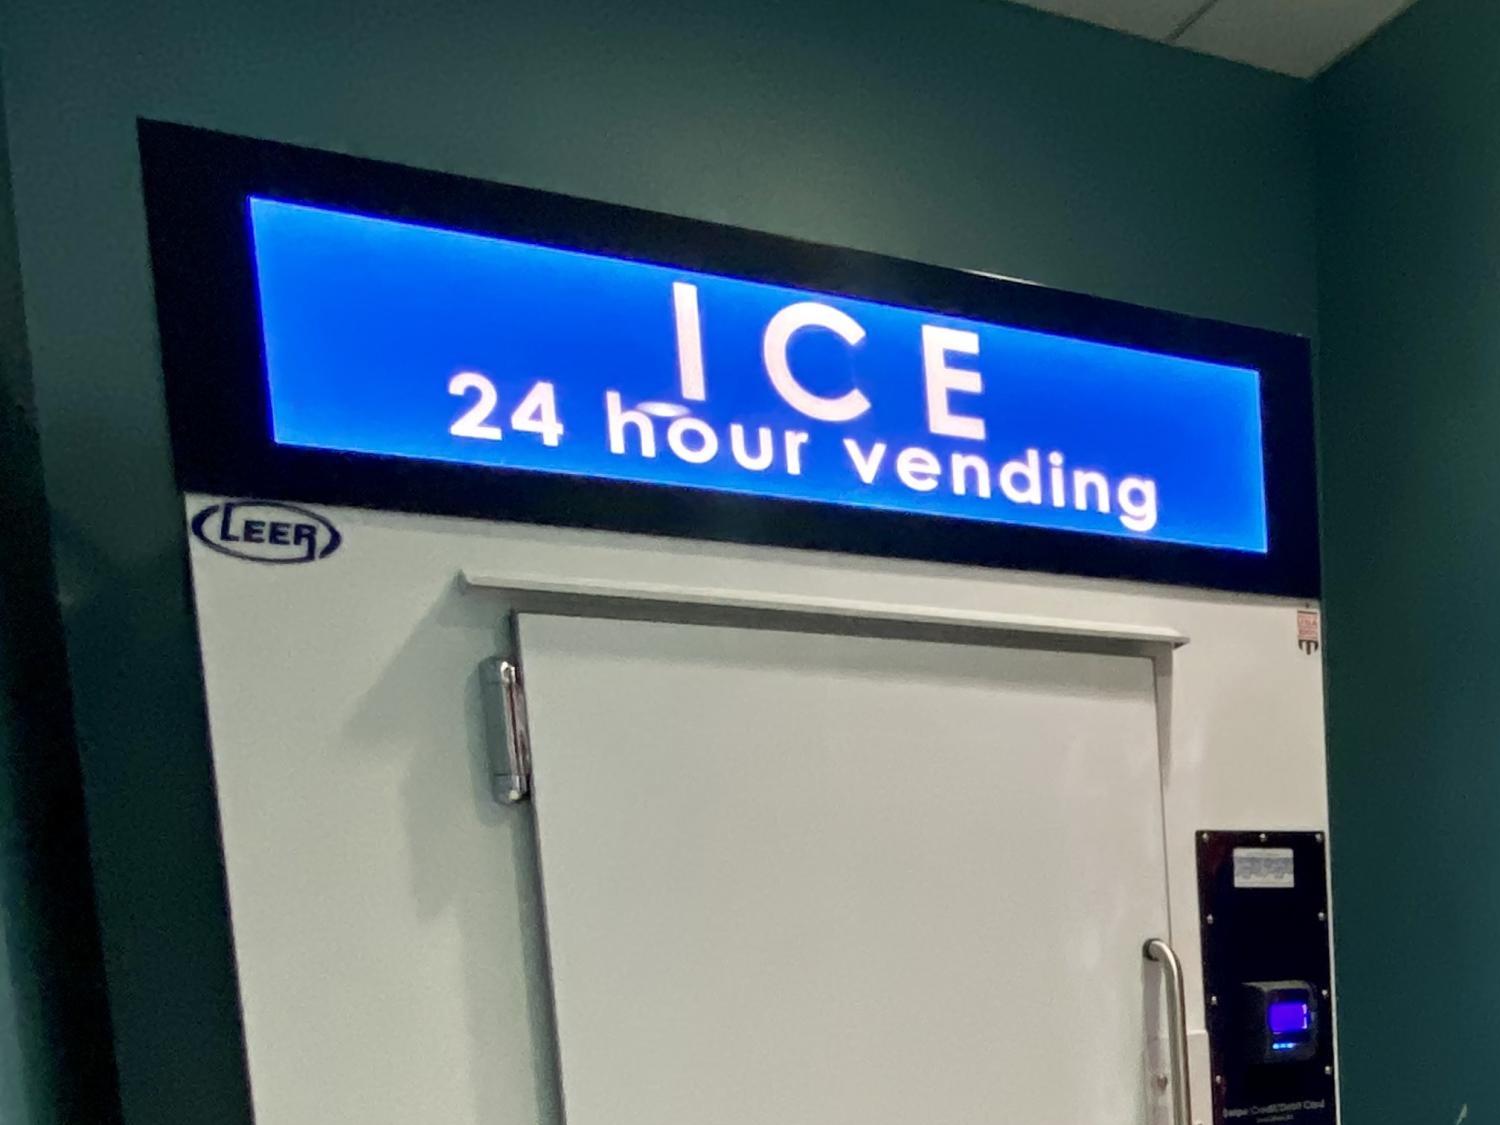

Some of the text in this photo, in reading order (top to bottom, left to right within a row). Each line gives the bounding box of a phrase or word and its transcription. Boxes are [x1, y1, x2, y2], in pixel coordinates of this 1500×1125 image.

[672, 281, 986, 441] ICE
[219, 502, 317, 561] LEER
[448, 371, 1158, 532] 24 hour vending
